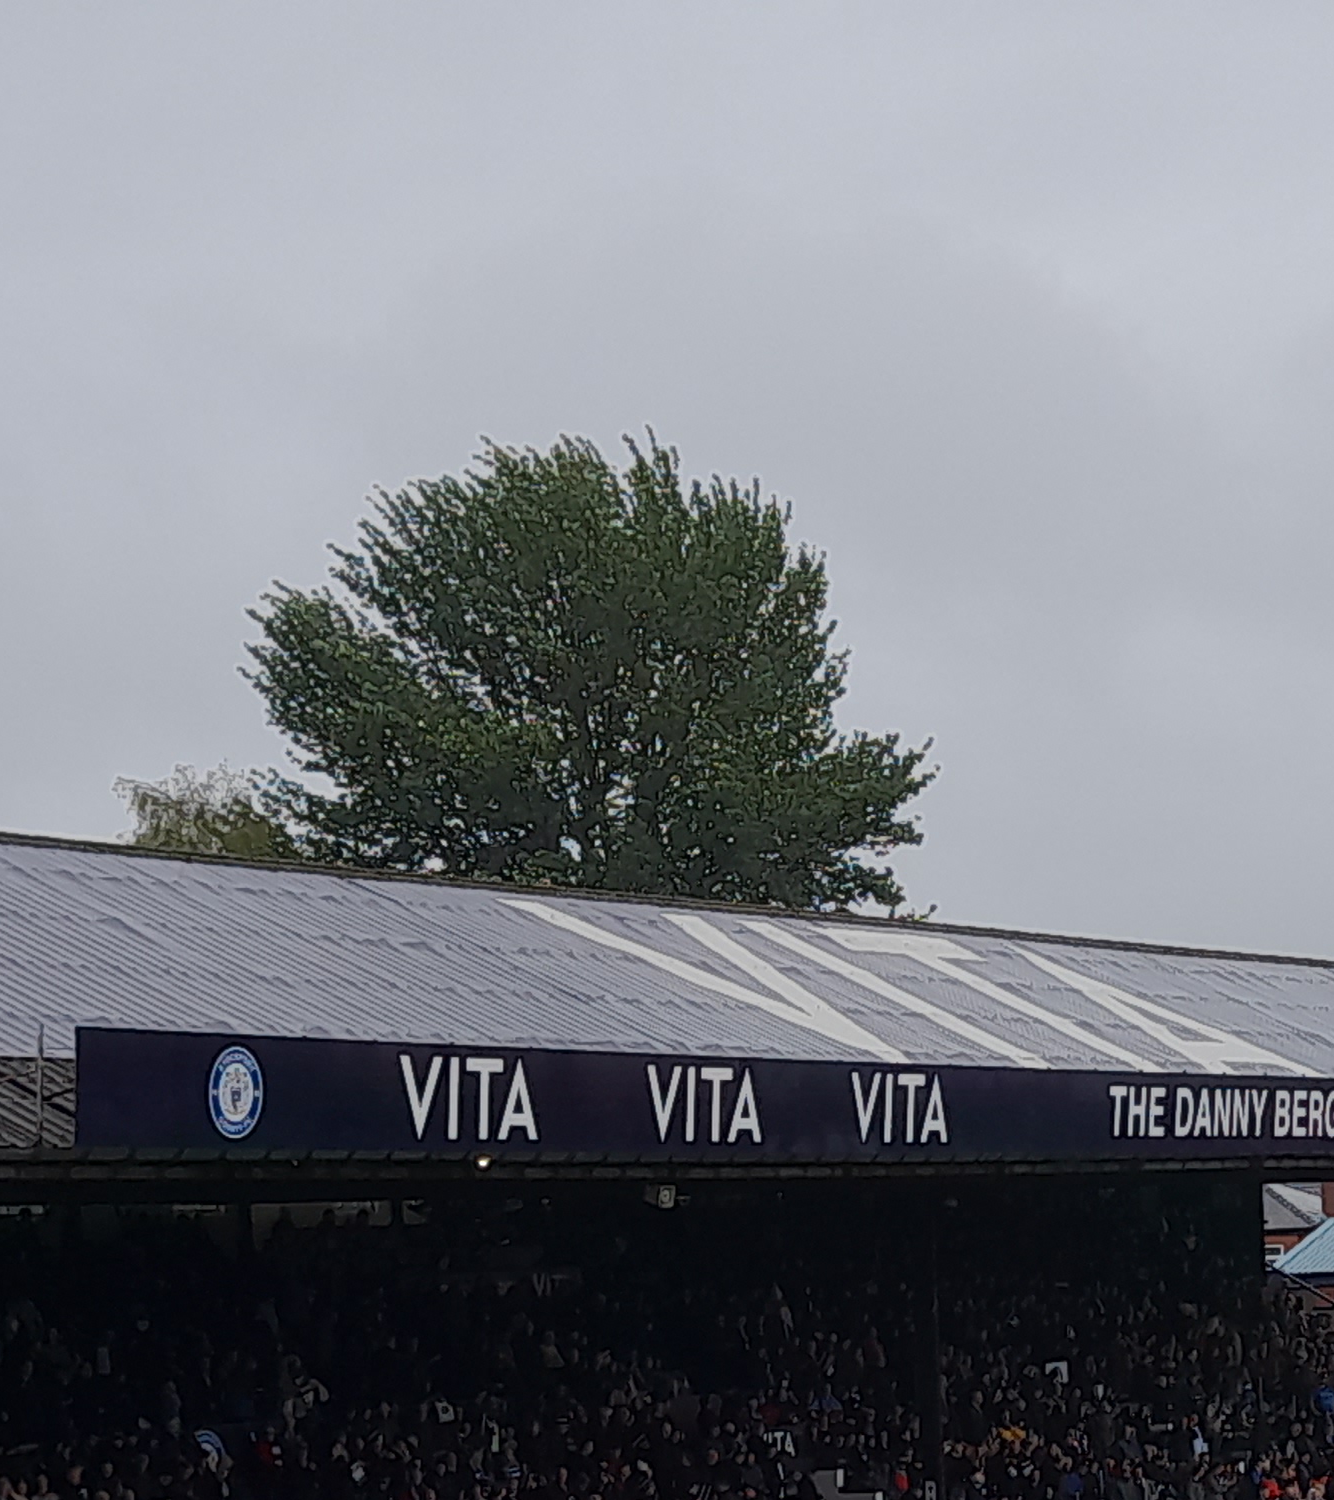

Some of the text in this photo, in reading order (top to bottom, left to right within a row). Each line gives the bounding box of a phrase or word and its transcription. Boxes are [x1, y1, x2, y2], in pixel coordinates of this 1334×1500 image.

[497, 899, 1299, 1075] VITA
[398, 1054, 540, 1142] VITA
[646, 1064, 763, 1144] VITA
[850, 1071, 949, 1145] VITA
[1109, 1085, 1166, 1138] THE
[1174, 1087, 1270, 1138] DANNY
